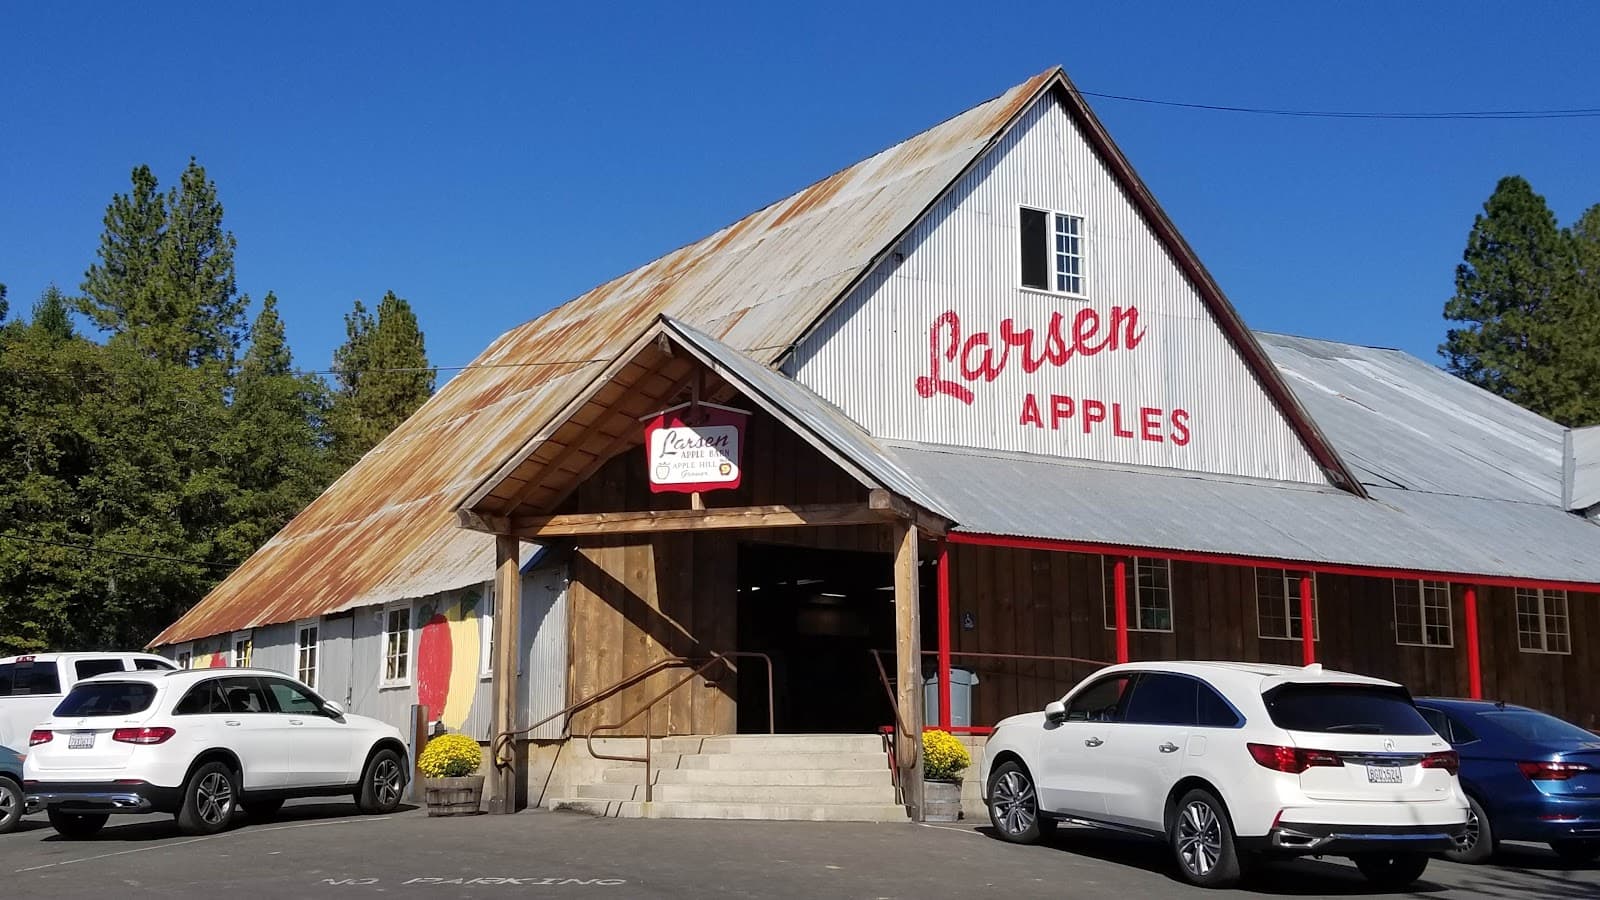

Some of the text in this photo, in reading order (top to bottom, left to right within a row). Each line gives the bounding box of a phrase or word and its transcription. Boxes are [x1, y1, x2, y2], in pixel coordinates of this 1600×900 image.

[915, 305, 1147, 406] Larsen
[1019, 393, 1191, 447] APPLES
[659, 430, 729, 458] Larsen
[681, 448, 730, 459] APPLE BARN
[673, 461, 696, 469] APPLE
[401, 877, 627, 886] PARKING
